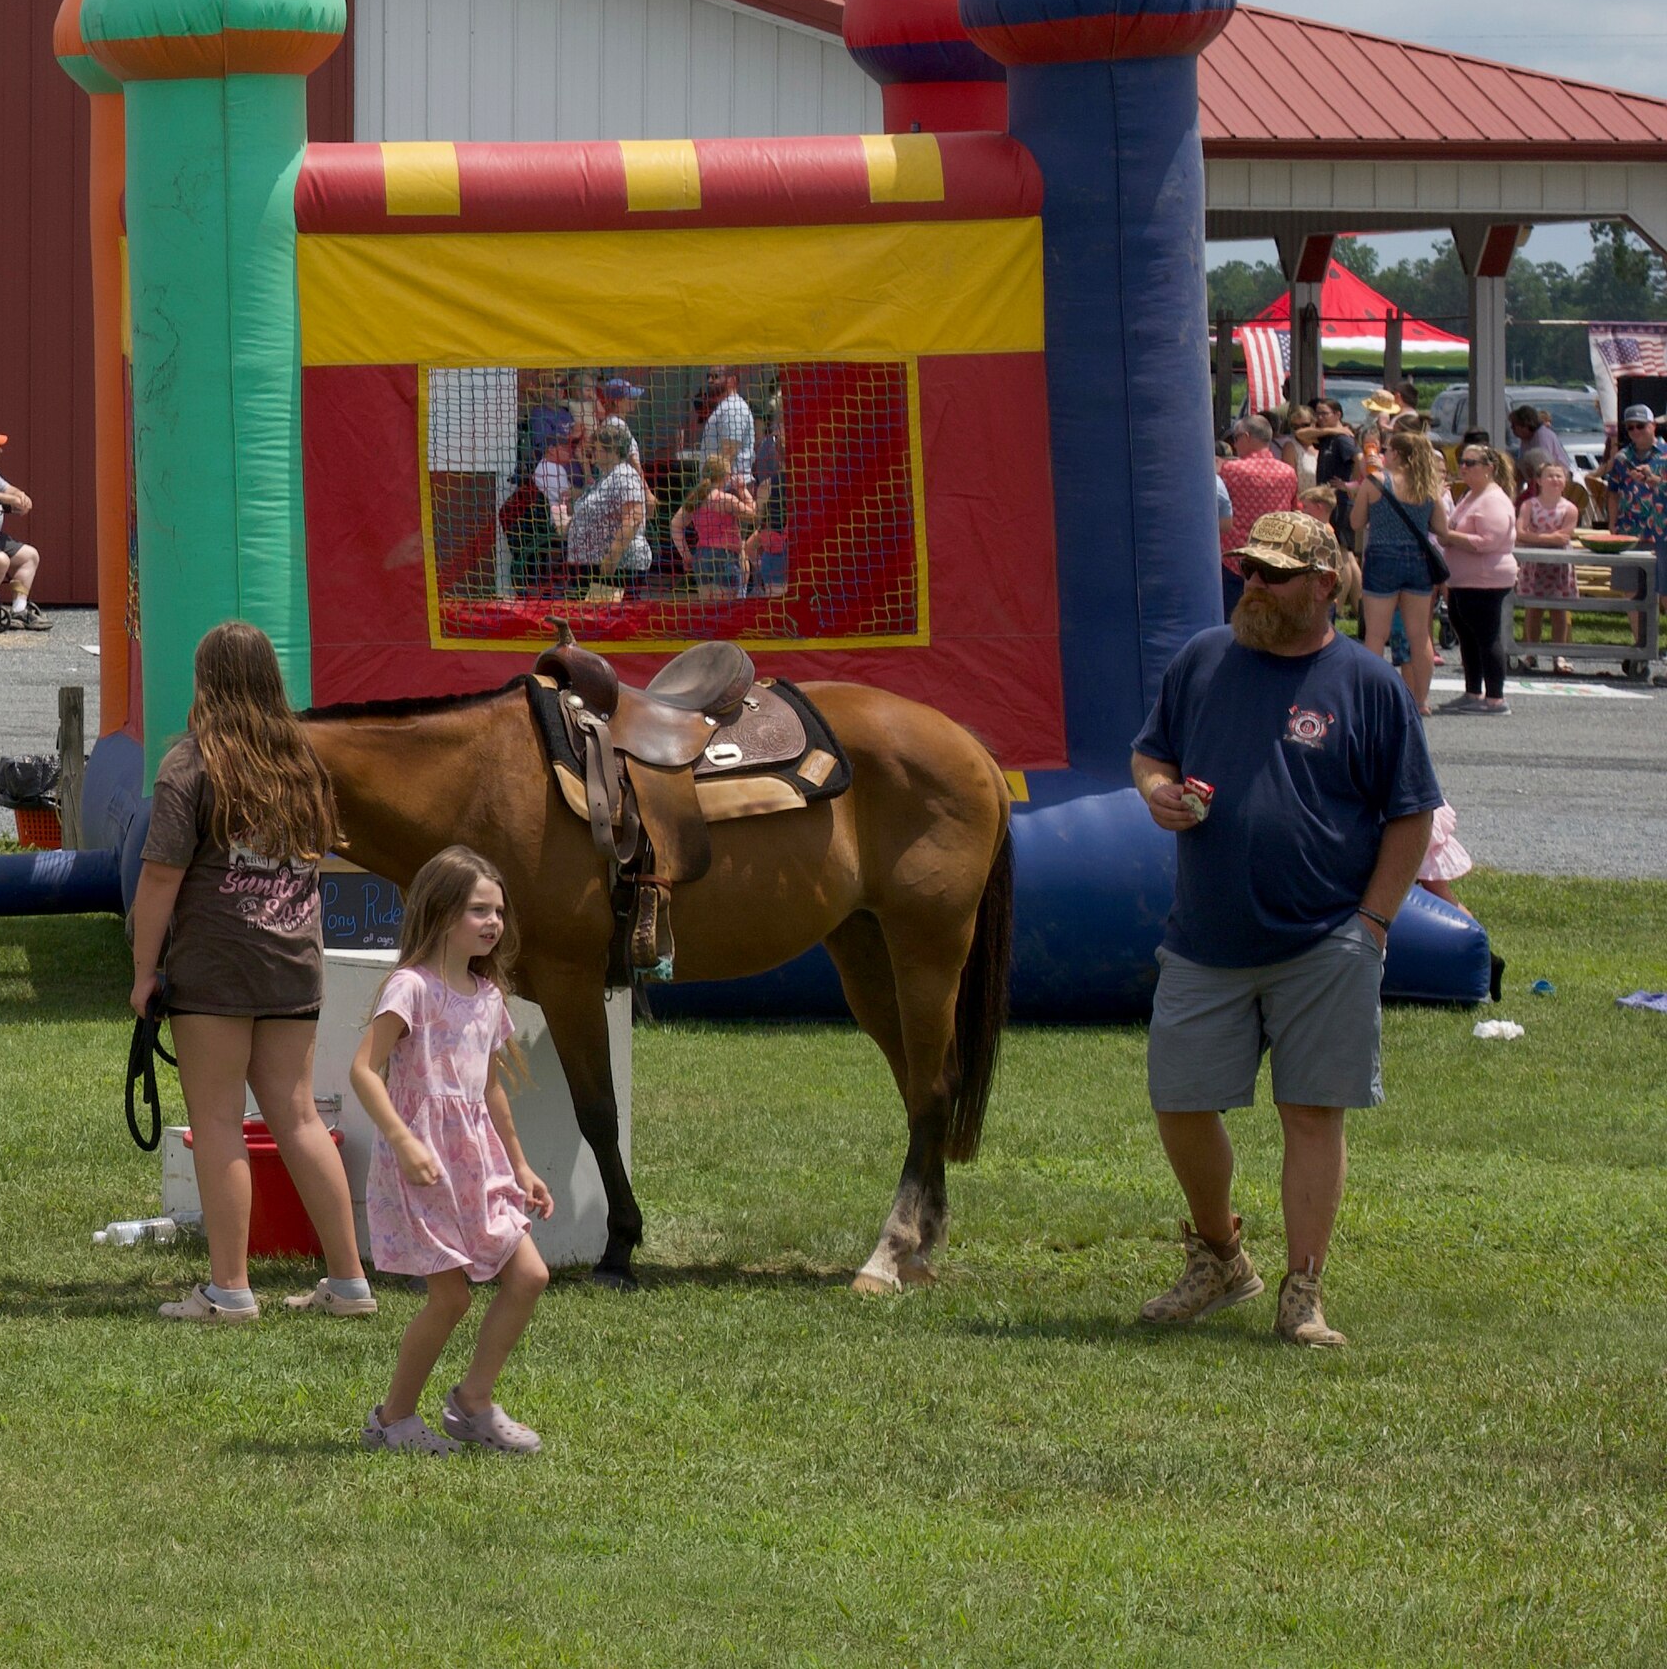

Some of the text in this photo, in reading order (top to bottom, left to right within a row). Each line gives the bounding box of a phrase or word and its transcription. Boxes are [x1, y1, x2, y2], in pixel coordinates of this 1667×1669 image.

[321, 881, 357, 937] Pony
[363, 933, 395, 947] all ages
